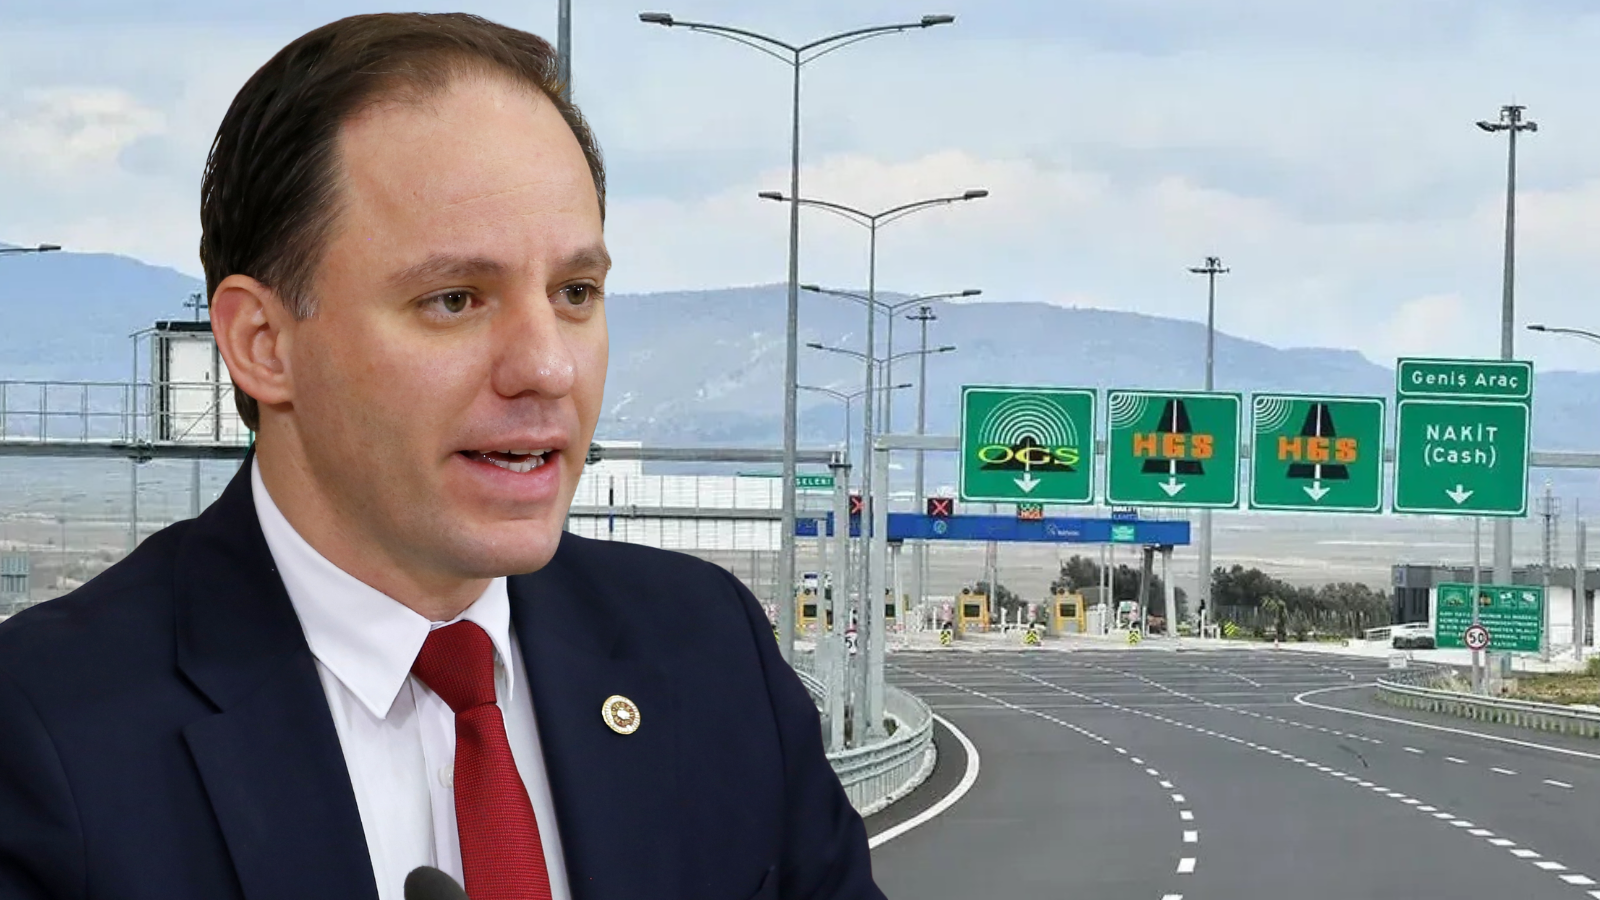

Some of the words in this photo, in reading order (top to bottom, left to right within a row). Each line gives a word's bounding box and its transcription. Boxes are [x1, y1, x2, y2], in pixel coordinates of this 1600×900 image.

[1411, 370, 1467, 387] Geniş
[1474, 372, 1519, 389] Araç
[1426, 423, 1499, 443] NAKİT
[978, 444, 1080, 465] OGS
[1133, 432, 1214, 458] HGS
[1277, 436, 1358, 462] HGS
[1424, 443, 1497, 468] (Cash)
[1468, 631, 1485, 644] 50
